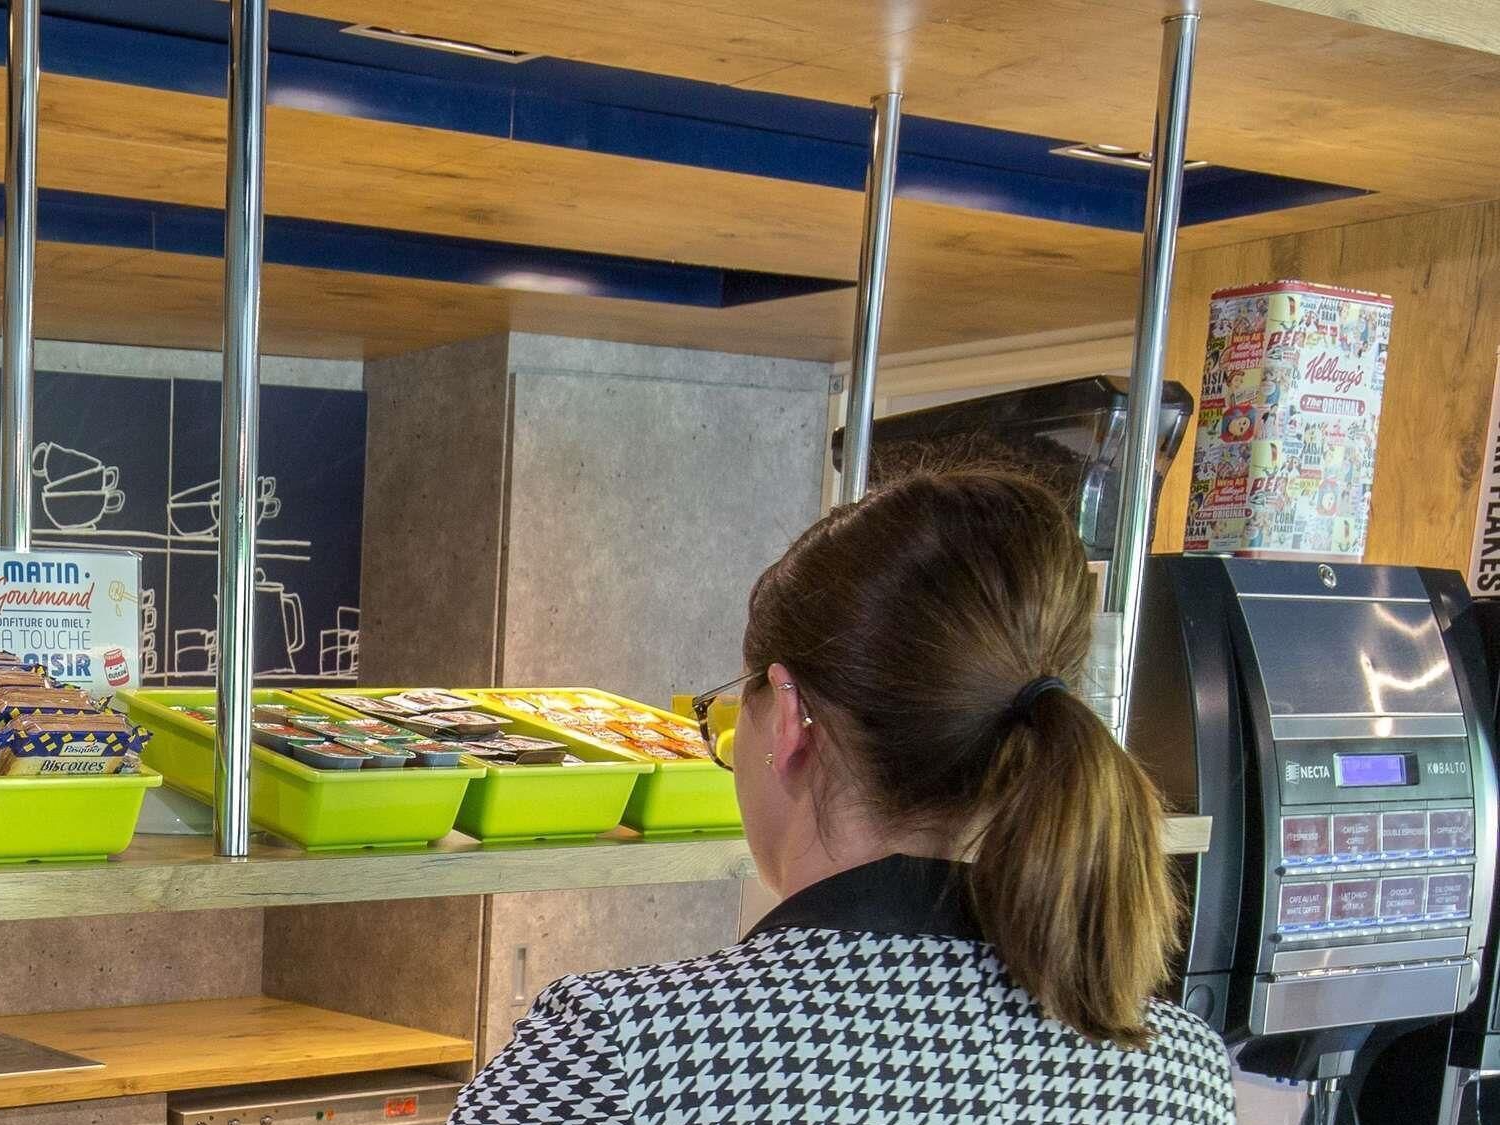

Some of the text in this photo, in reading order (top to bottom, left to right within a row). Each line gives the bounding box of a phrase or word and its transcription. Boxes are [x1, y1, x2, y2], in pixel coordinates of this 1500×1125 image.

[1305, 352, 1364, 393] Kellogg's
[3, 561, 79, 584] MATIN
[45, 617, 59, 628] OU
[61, 617, 83, 628] MIEL
[21, 630, 91, 650] TOUCHE
[40, 757, 106, 773] Biscottes
[1301, 766, 1330, 779] NECTA
[1427, 762, 1467, 775] KOBALTO
